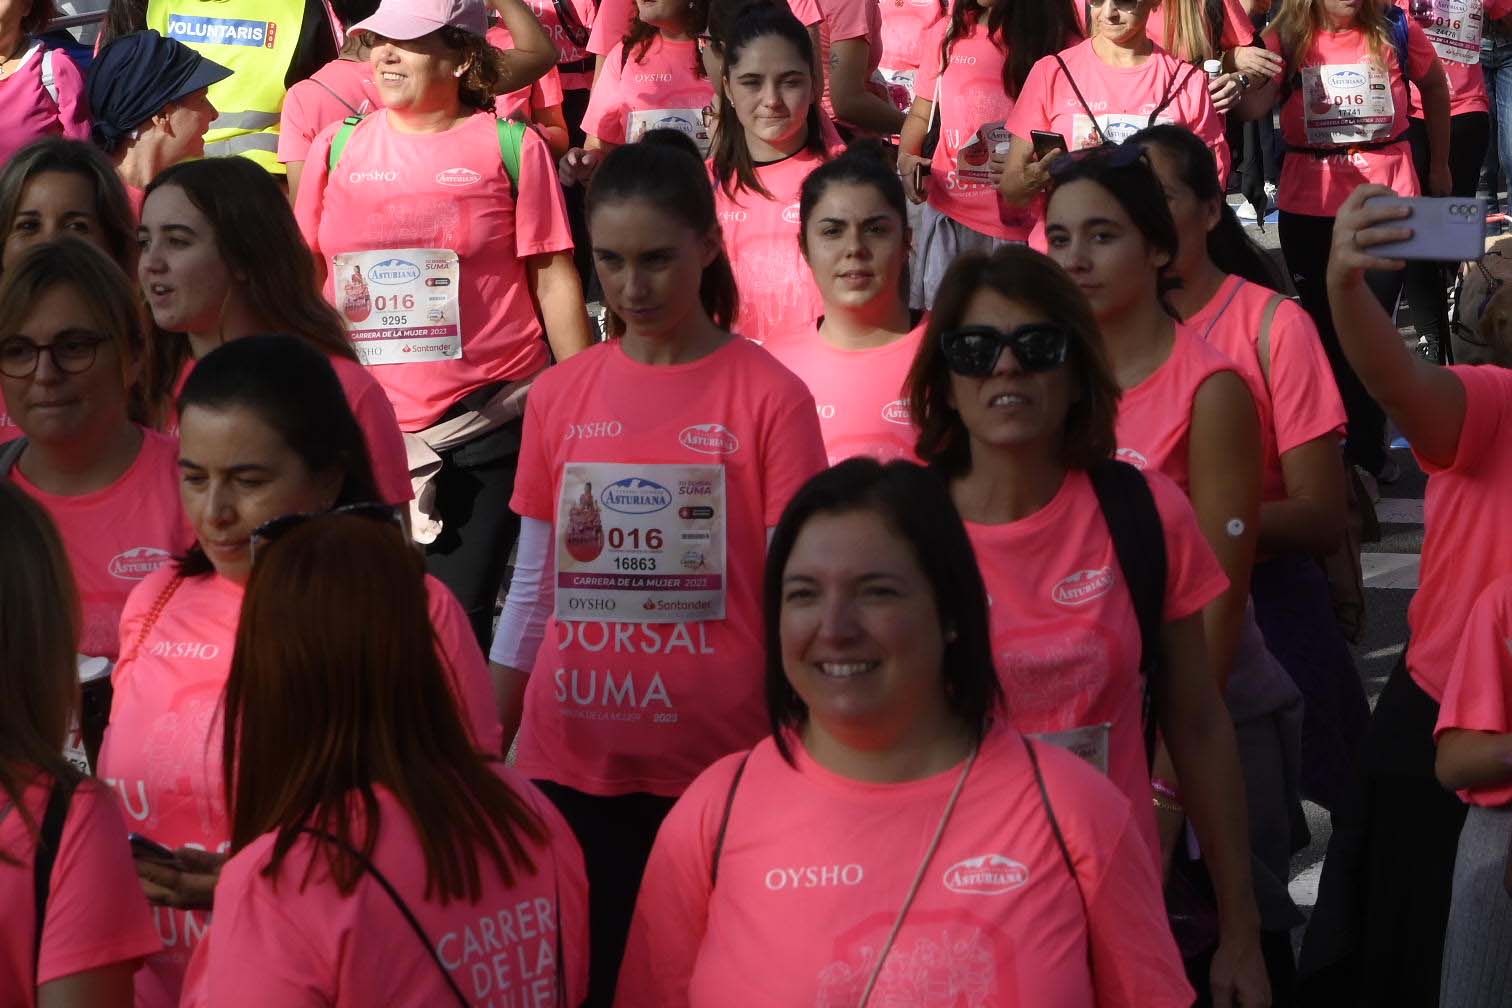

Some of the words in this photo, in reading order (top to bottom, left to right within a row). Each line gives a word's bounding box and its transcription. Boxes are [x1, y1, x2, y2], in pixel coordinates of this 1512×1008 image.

[1436, 16, 1461, 30] 016
[168, 20, 263, 41] VOLUNTARIS
[1334, 94, 1364, 106] 016
[371, 266, 417, 280] ASTURIANA
[425, 263, 450, 271] SUMA
[374, 294, 415, 311] 016
[381, 315, 408, 326] 9295
[382, 330, 392, 338] DE
[403, 329, 428, 337] MUJER
[678, 486, 712, 495] SUMA
[605, 491, 666, 506] ASTURIANA
[608, 527, 664, 549] 016
[613, 557, 657, 571] 16863
[574, 577, 615, 586] CARRERA
[619, 578, 630, 586] DE
[632, 578, 644, 586] LA
[647, 578, 681, 587] MUJER
[569, 598, 616, 611] OYSHO
[657, 600, 711, 610] Santander
[555, 668, 673, 708] SUMA
[765, 863, 864, 891] OYSHO
[952, 870, 1023, 887] ASTURIANA
[472, 952, 511, 998] DE
[518, 938, 557, 980] LA
